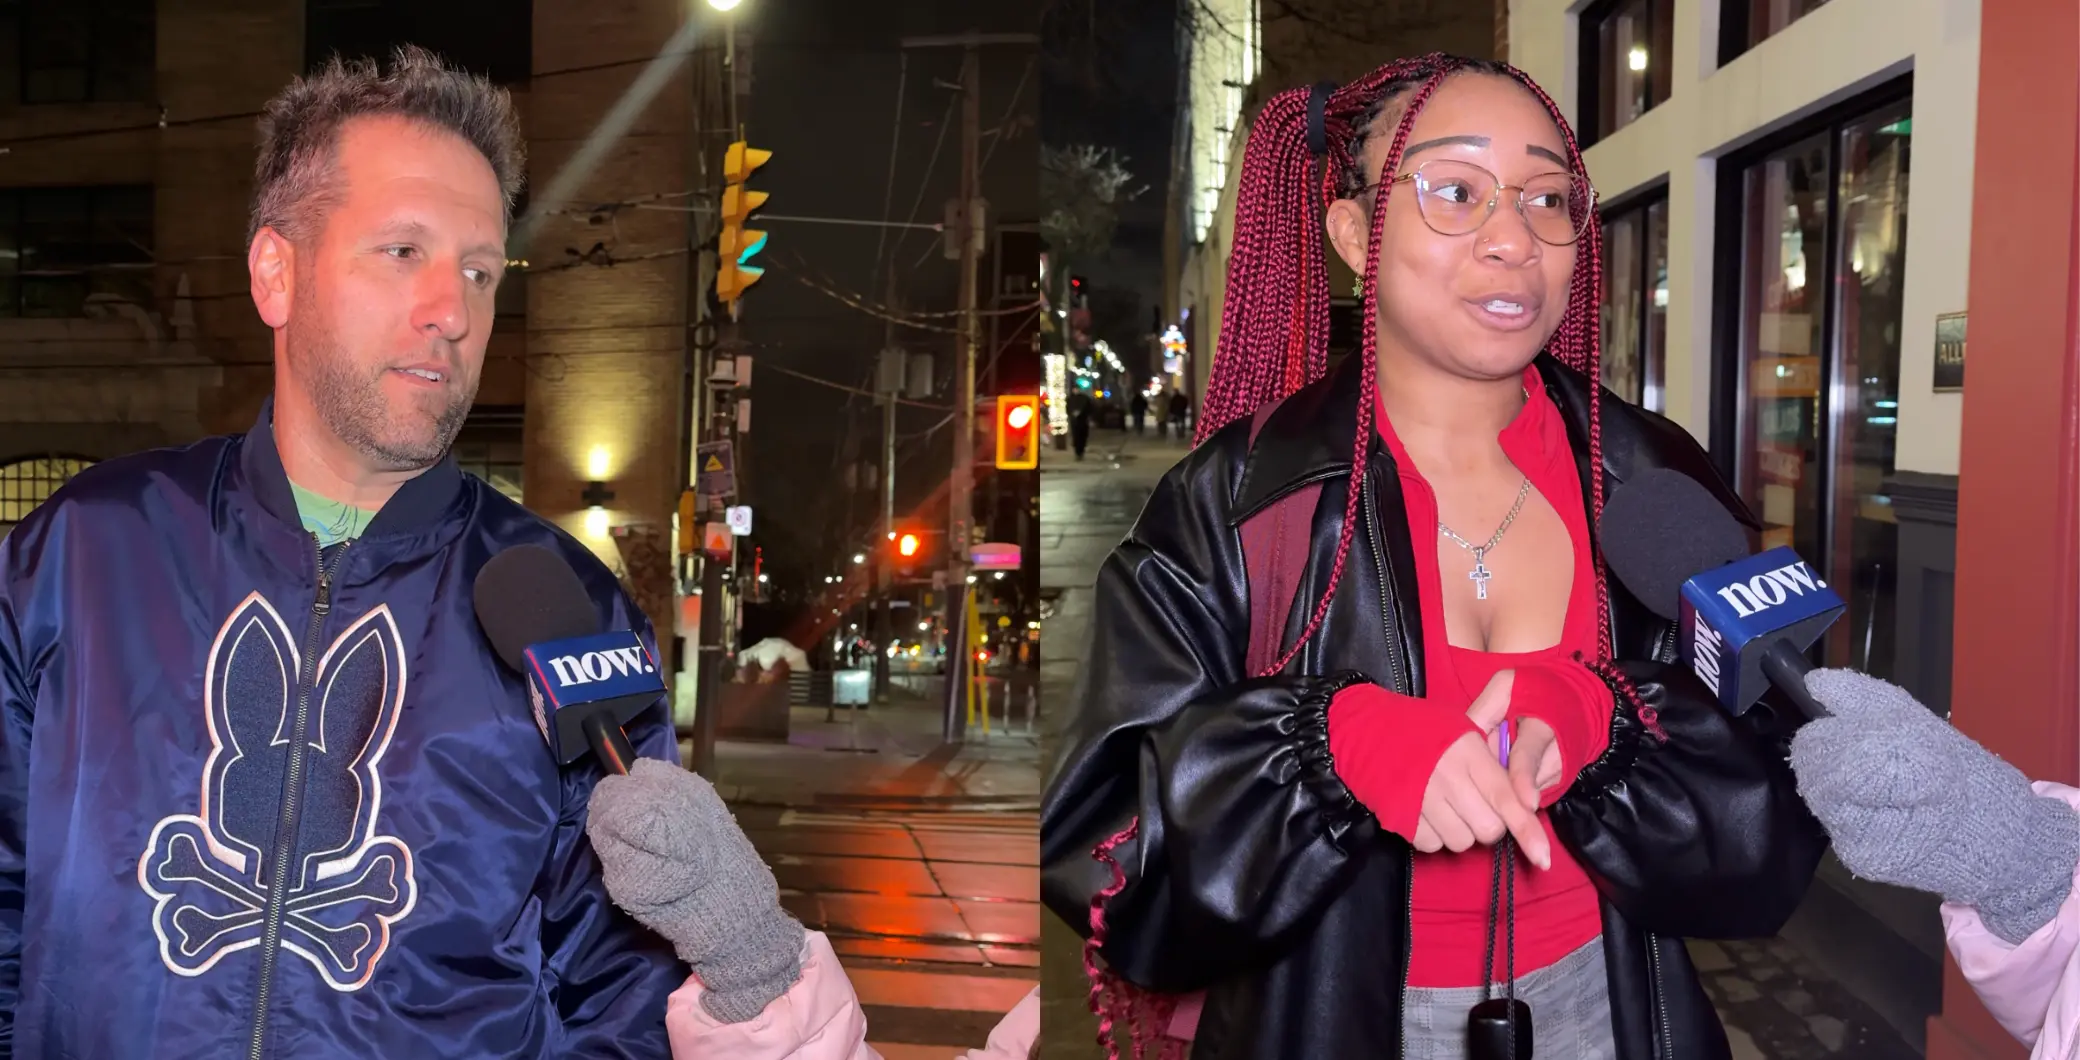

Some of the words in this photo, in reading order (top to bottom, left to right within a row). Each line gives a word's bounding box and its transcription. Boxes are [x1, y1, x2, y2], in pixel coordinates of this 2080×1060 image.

[1940, 342, 1967, 364] ALL
[1717, 561, 1828, 618] now.
[548, 646, 654, 687] now.
[1694, 609, 1722, 699] now.
